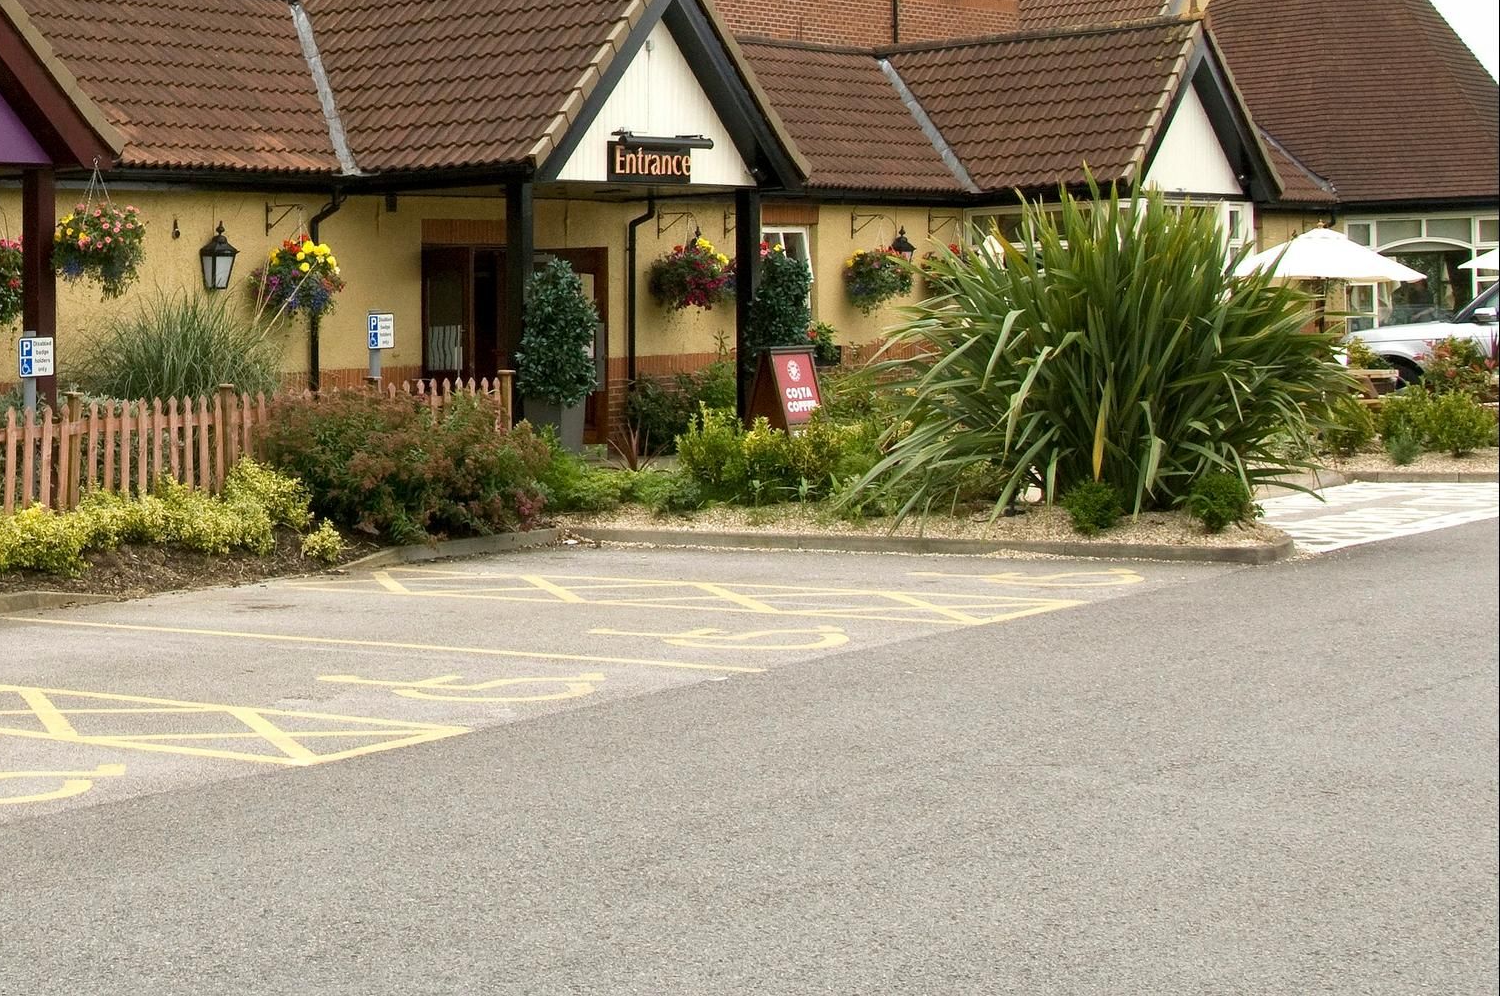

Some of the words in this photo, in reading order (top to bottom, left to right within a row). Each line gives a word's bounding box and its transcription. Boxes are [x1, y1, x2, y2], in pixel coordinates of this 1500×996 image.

[615, 145, 692, 176] Entrance
[23, 341, 31, 355] P
[785, 386, 813, 399] COSTA
